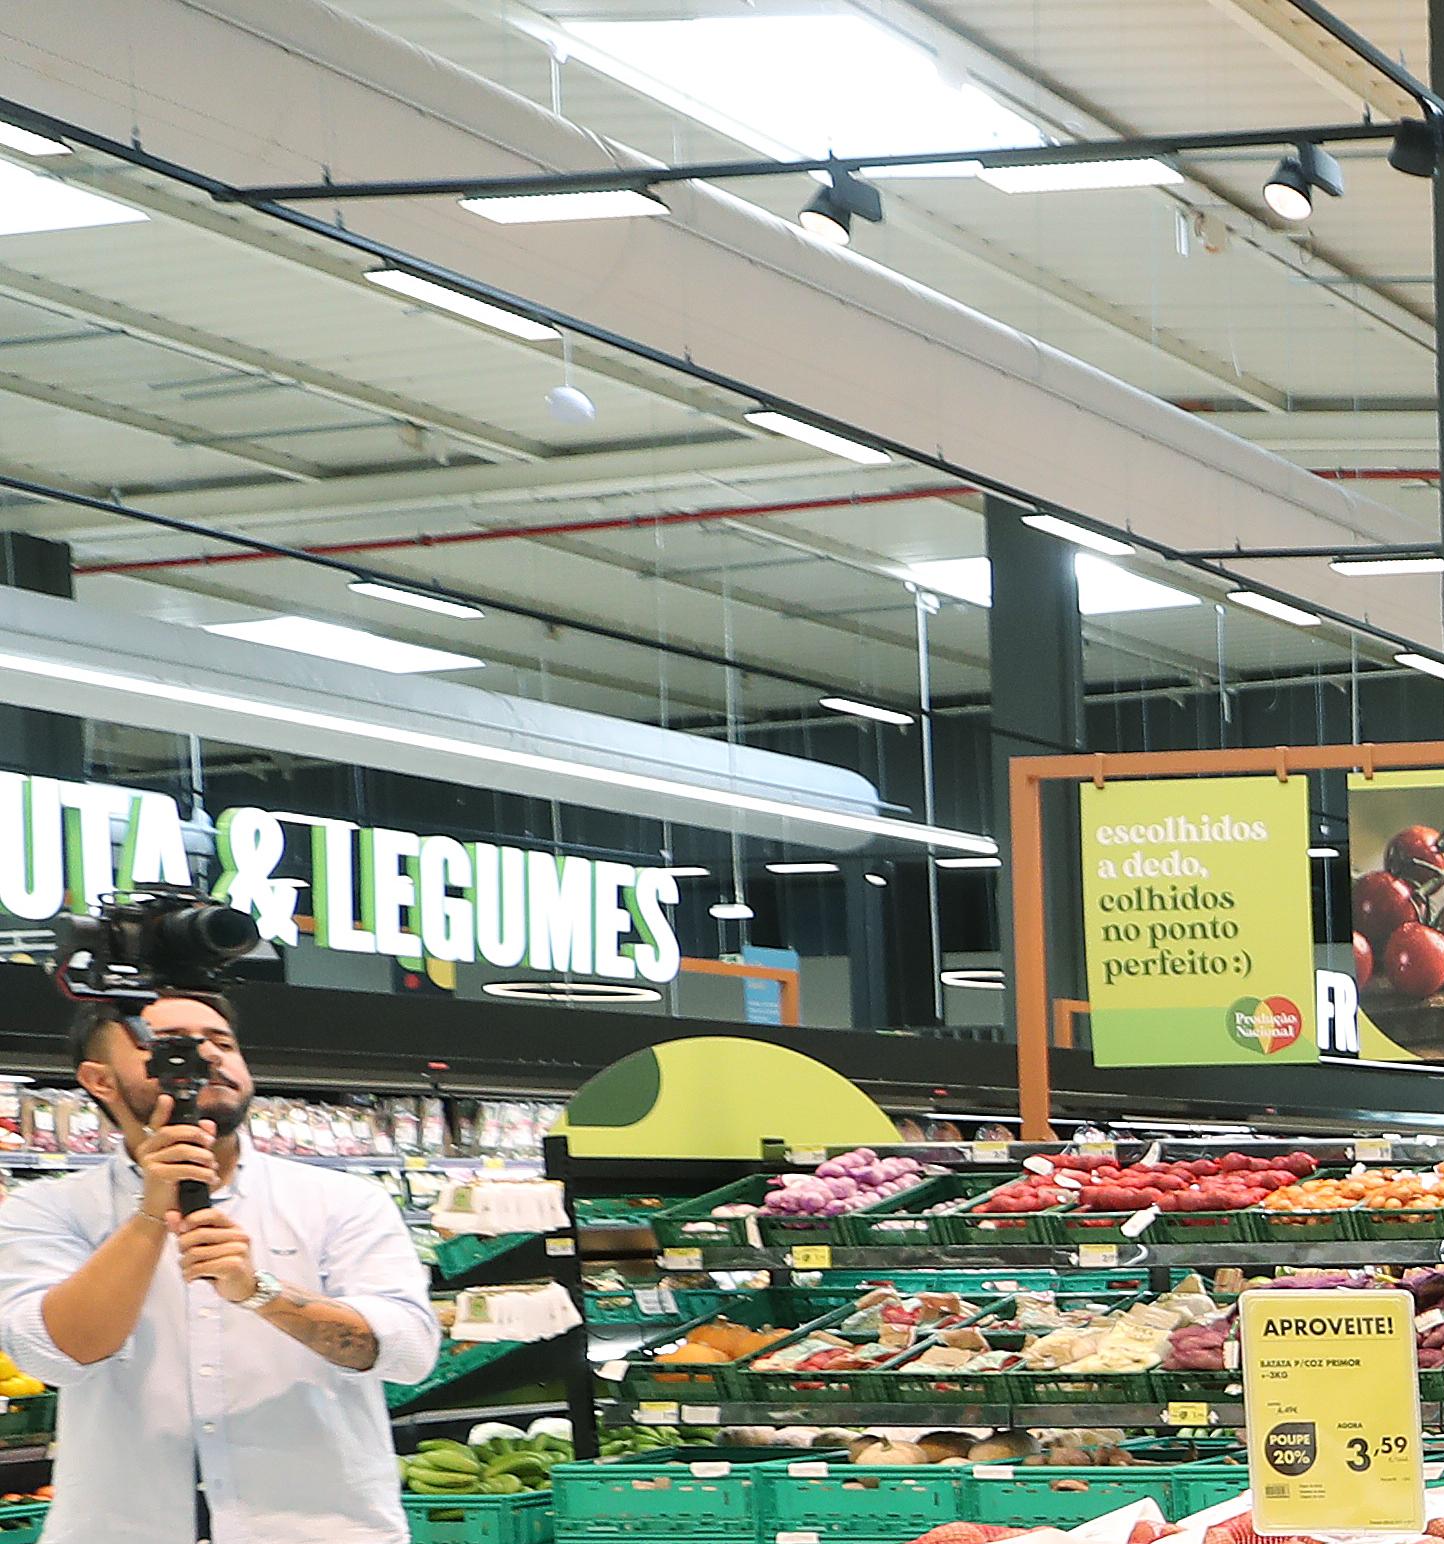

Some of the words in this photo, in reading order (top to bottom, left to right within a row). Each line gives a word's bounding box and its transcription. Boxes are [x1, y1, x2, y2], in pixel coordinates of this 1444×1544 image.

[1096, 814, 1269, 845] escolhidos
[1097, 858, 1117, 879] a
[1122, 851, 1210, 879] dedo,
[313, 820, 681, 984] LEGUMES
[1099, 884, 1236, 912] colhidos
[1101, 922, 1140, 942] no
[1149, 916, 1239, 949] ponto
[1102, 949, 1228, 985] perfeito
[1234, 1011, 1298, 1027] Produção
[1236, 1025, 1296, 1038] Nacional
[1263, 1317, 1394, 1337] APROVEITE!
[1269, 1433, 1311, 1446] POUPE
[1273, 1450, 1311, 1465] 20%
